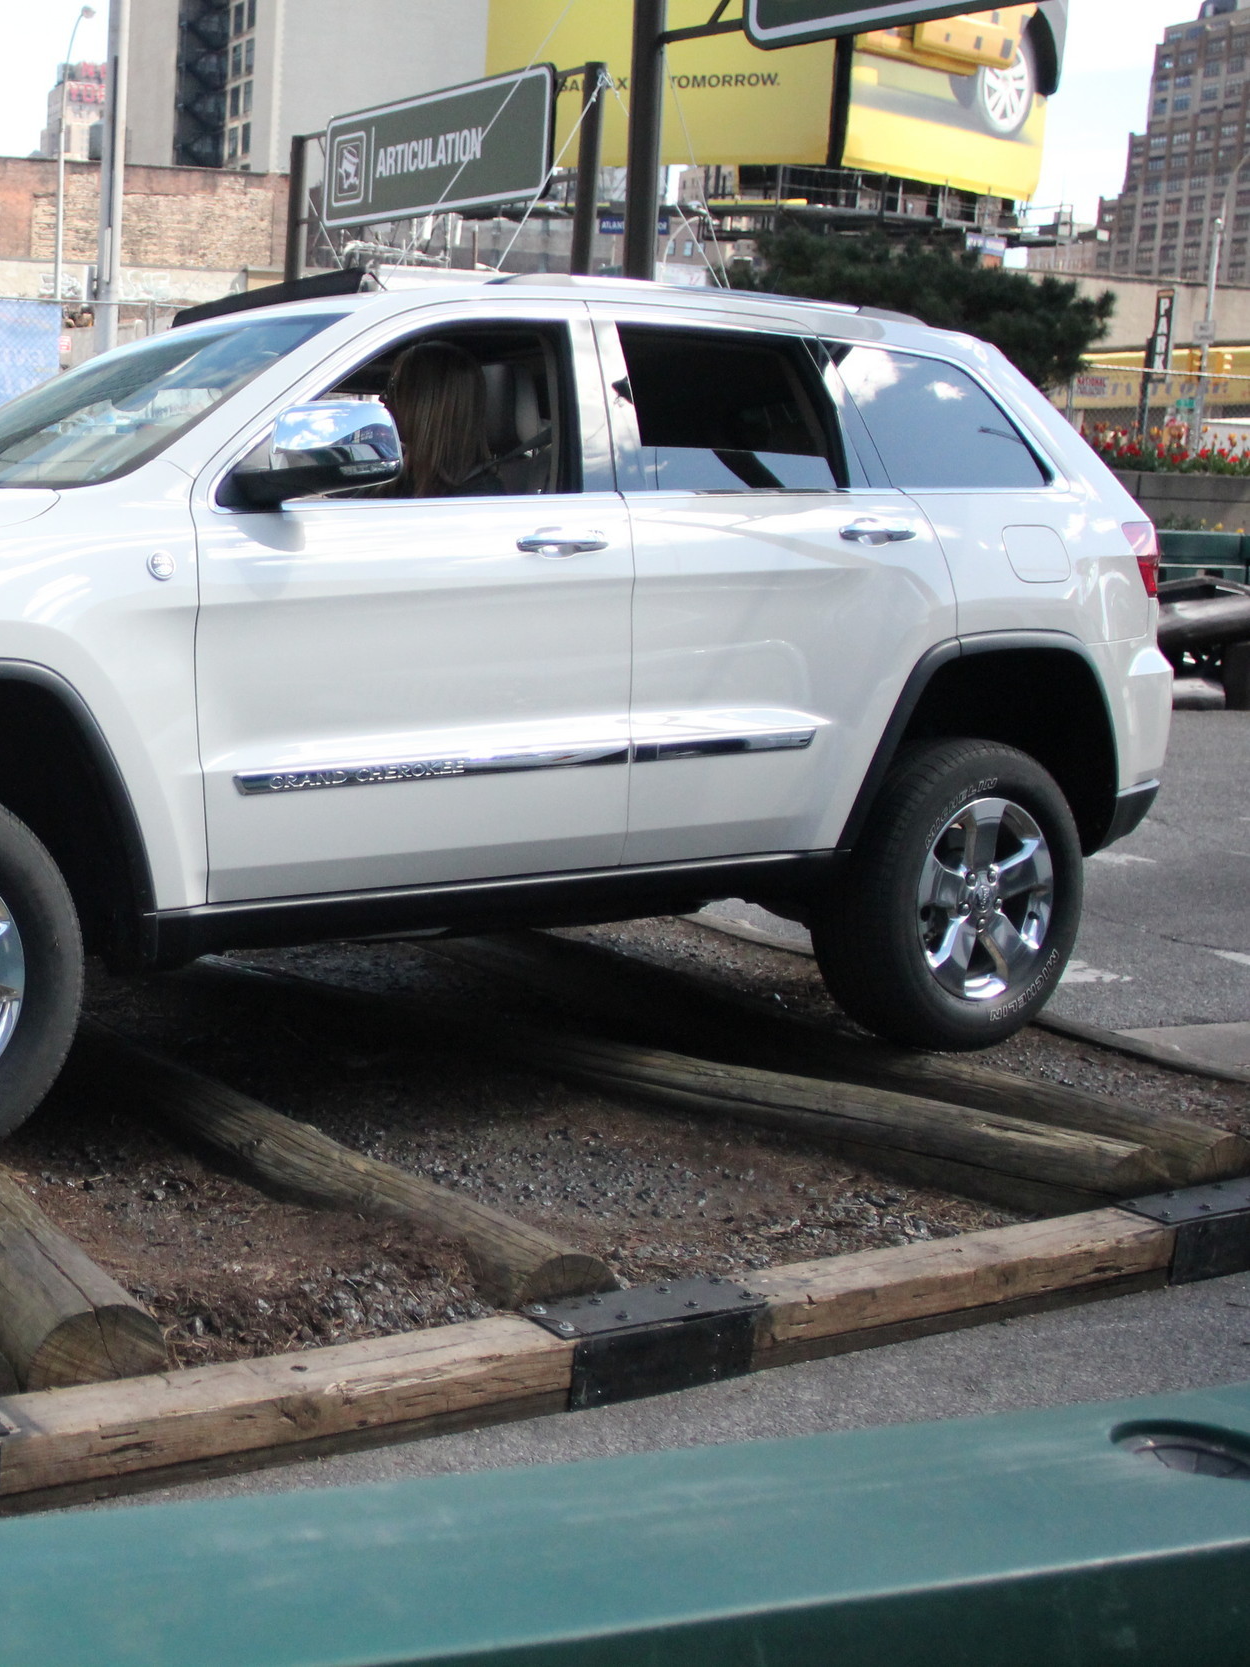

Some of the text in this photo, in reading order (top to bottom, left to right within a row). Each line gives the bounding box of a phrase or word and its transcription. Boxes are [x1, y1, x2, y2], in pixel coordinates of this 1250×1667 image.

[670, 72, 781, 89] TOMORROW.
[375, 127, 482, 178] ARTICULATION
[1153, 297, 1171, 370] PARK
[268, 759, 466, 790] GRAND CHEROKEE
[924, 777, 998, 850] MICHELIN
[989, 948, 1060, 1022] MICHELIN
